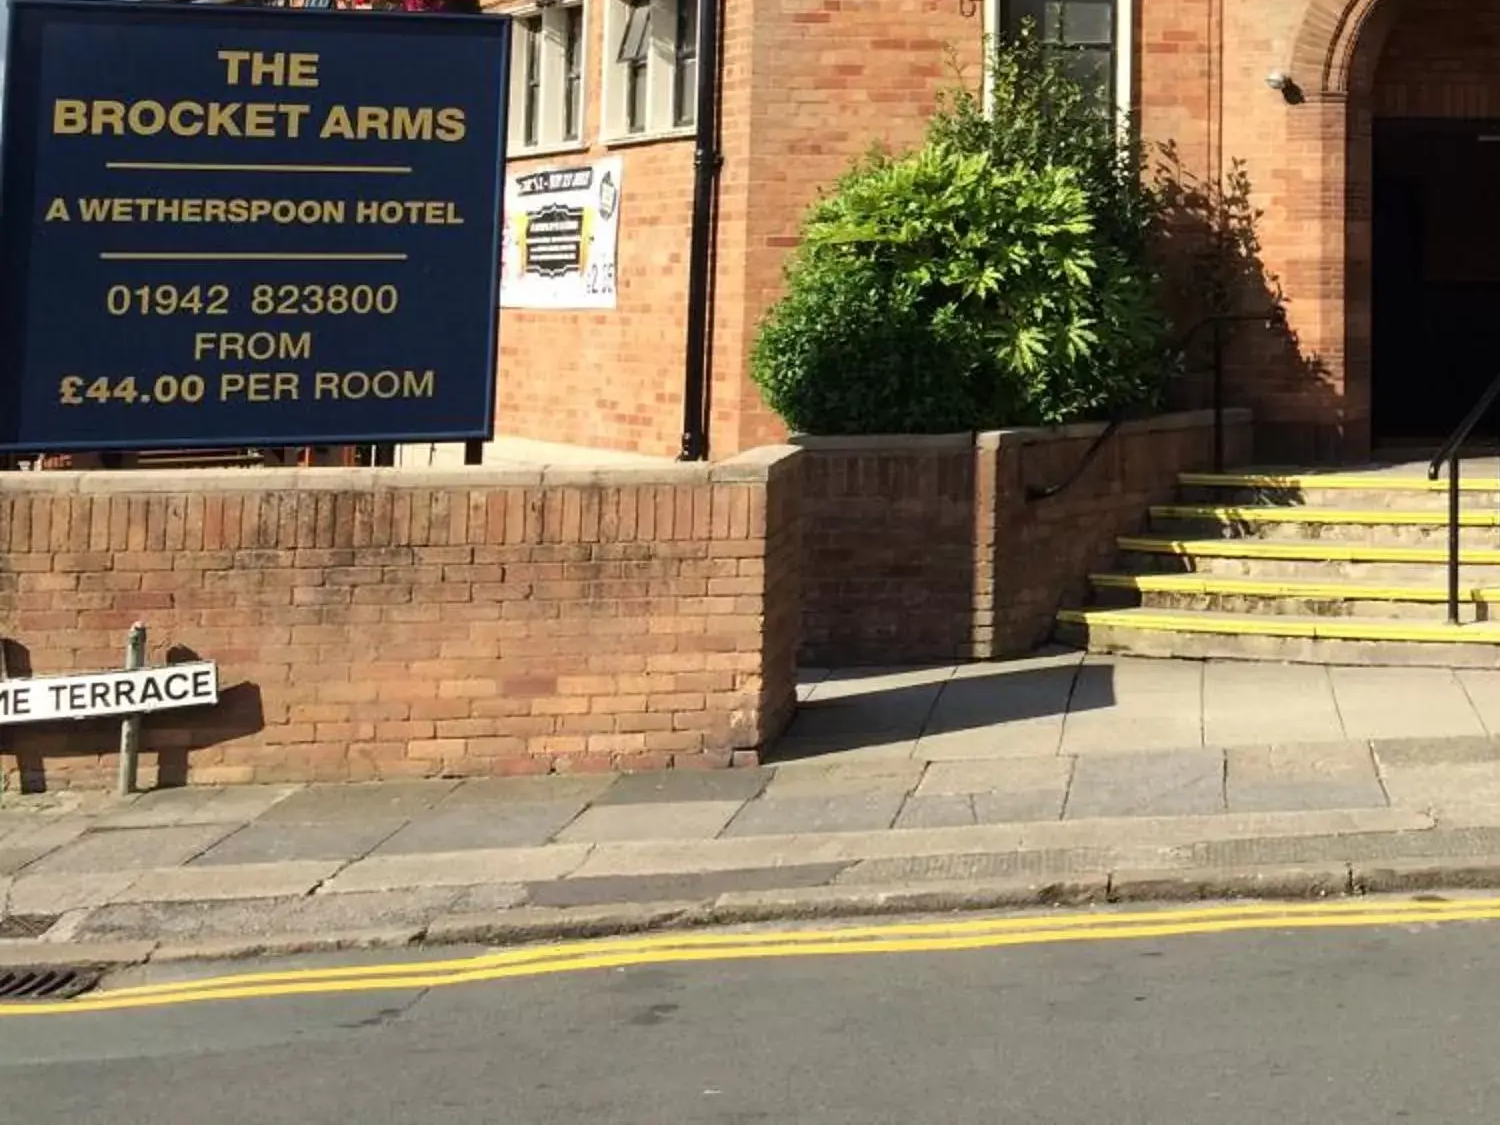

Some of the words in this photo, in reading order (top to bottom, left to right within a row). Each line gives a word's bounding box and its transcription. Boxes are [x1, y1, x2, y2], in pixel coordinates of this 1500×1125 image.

[217, 50, 320, 87] THE
[53, 99, 311, 139] BROCKET
[319, 105, 466, 142] ARMS
[45, 198, 71, 222] A
[78, 198, 345, 224] WETHERSPOON
[356, 201, 465, 224] HOTEL
[106, 284, 229, 315] 01942
[250, 284, 398, 315] 823800
[194, 332, 312, 360] FROM
[59, 375, 205, 404] £44.00
[219, 373, 300, 401] PER
[314, 370, 435, 400] ROOM
[48, 670, 212, 712] TERRACE
